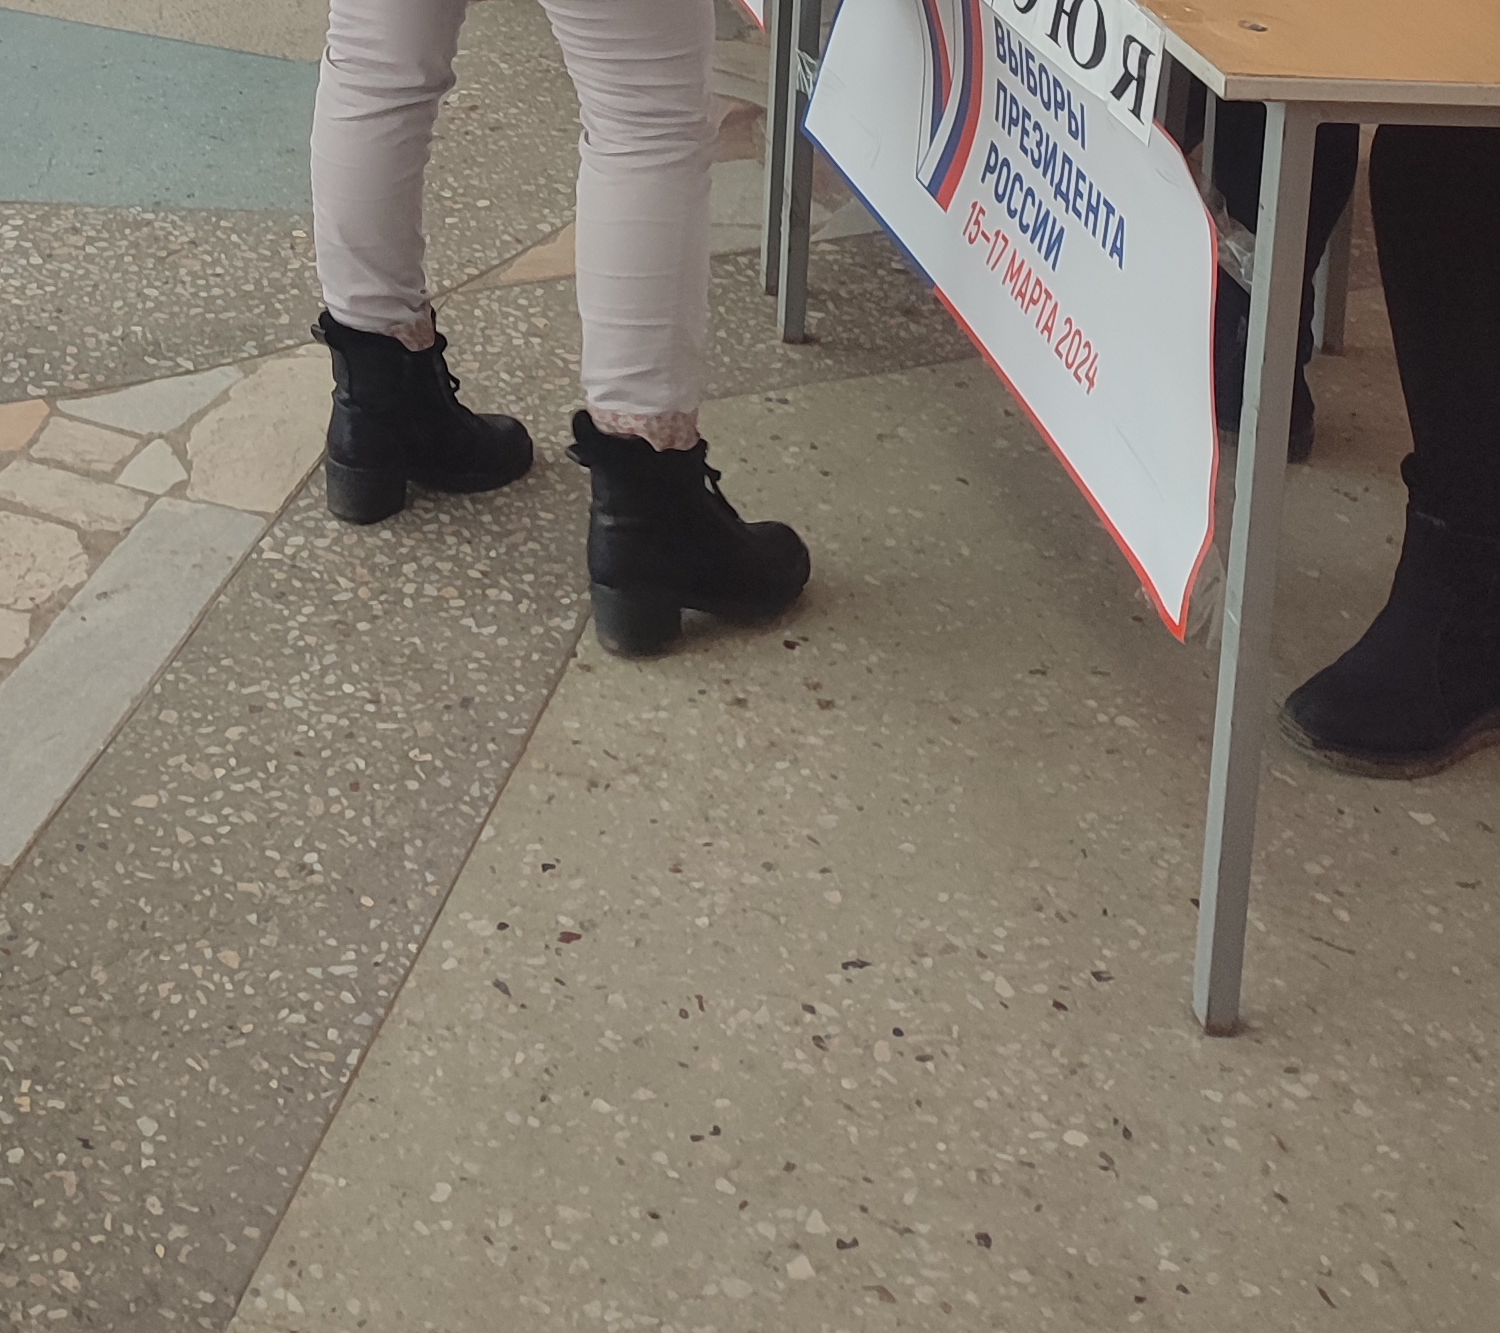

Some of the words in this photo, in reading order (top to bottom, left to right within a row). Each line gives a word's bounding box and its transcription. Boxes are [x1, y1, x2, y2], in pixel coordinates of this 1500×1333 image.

[994, 15, 1087, 151] ВЫБОРЫ
[981, 140, 1065, 272] РОССИИ
[994, 78, 1126, 271] ПРЕЗИДЕНТА
[1001, 249, 1060, 344] МАРТА
[1054, 316, 1099, 395] 2024
